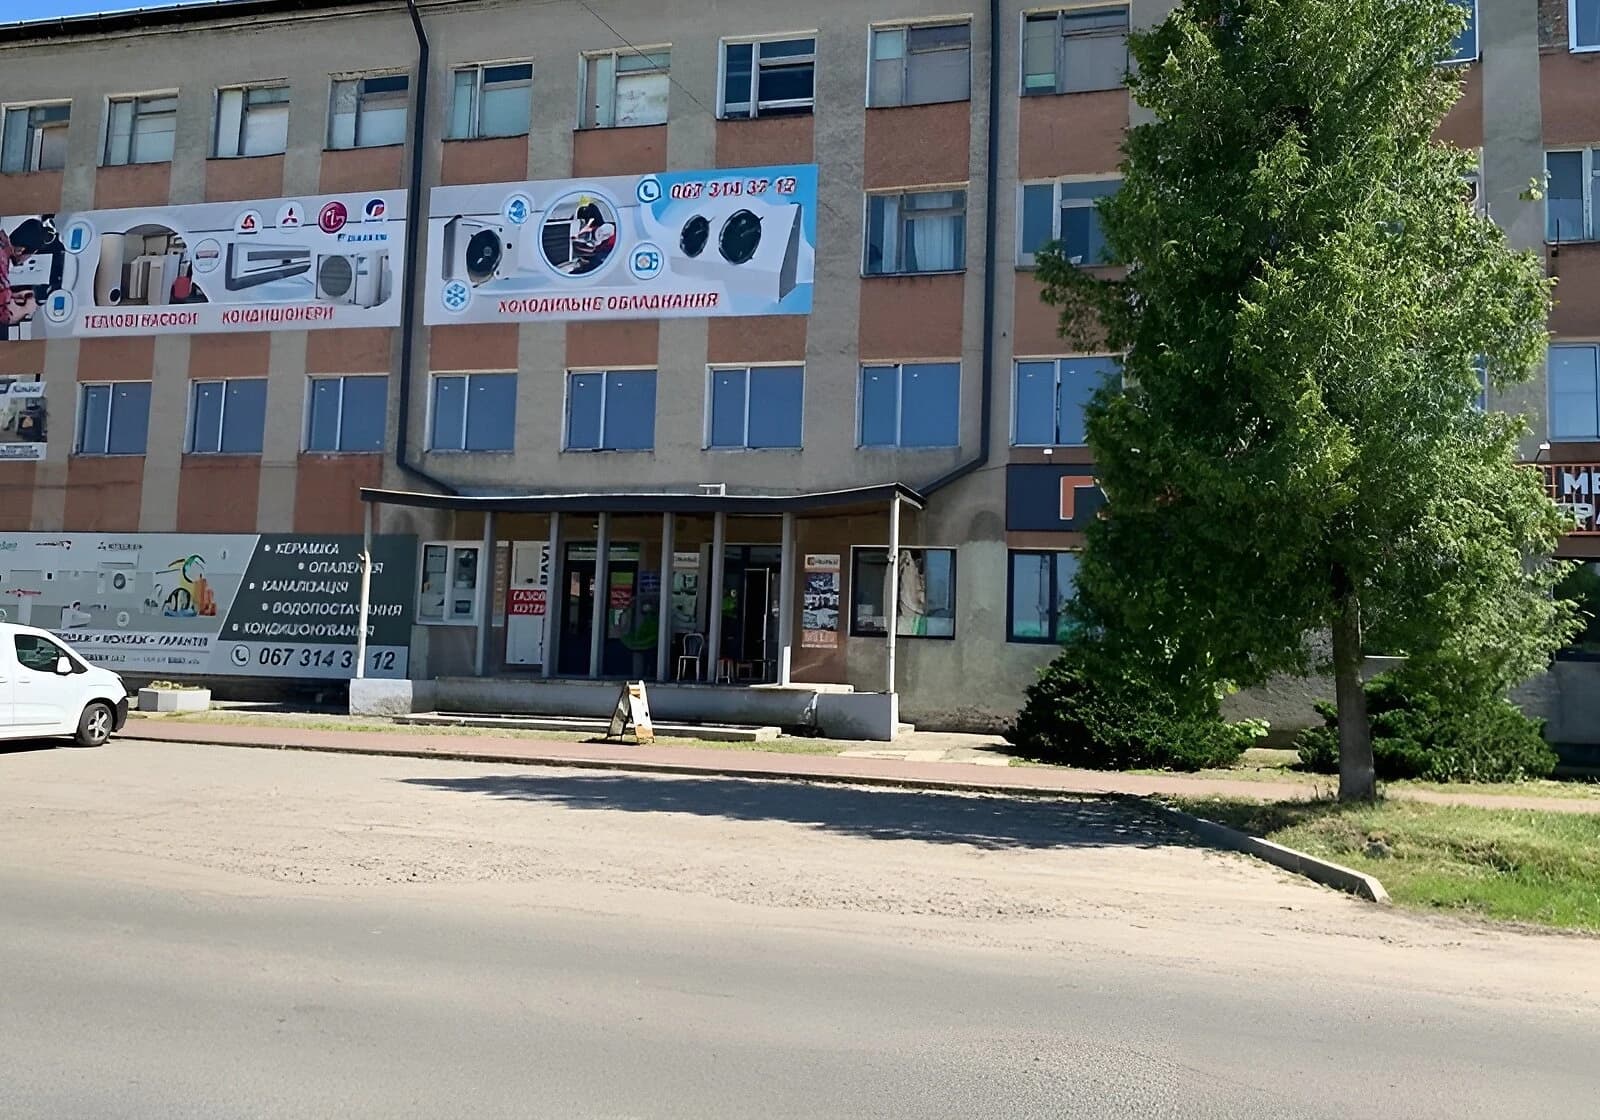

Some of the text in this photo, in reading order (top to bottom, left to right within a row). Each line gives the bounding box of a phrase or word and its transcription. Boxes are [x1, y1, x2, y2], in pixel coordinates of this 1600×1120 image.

[498, 292, 719, 313] ХОЛОДИЛЬНЕ ОБЛАДНАННЯ
[258, 647, 294, 667] 067
[299, 648, 335, 668] 314
[372, 651, 396, 671] 12
